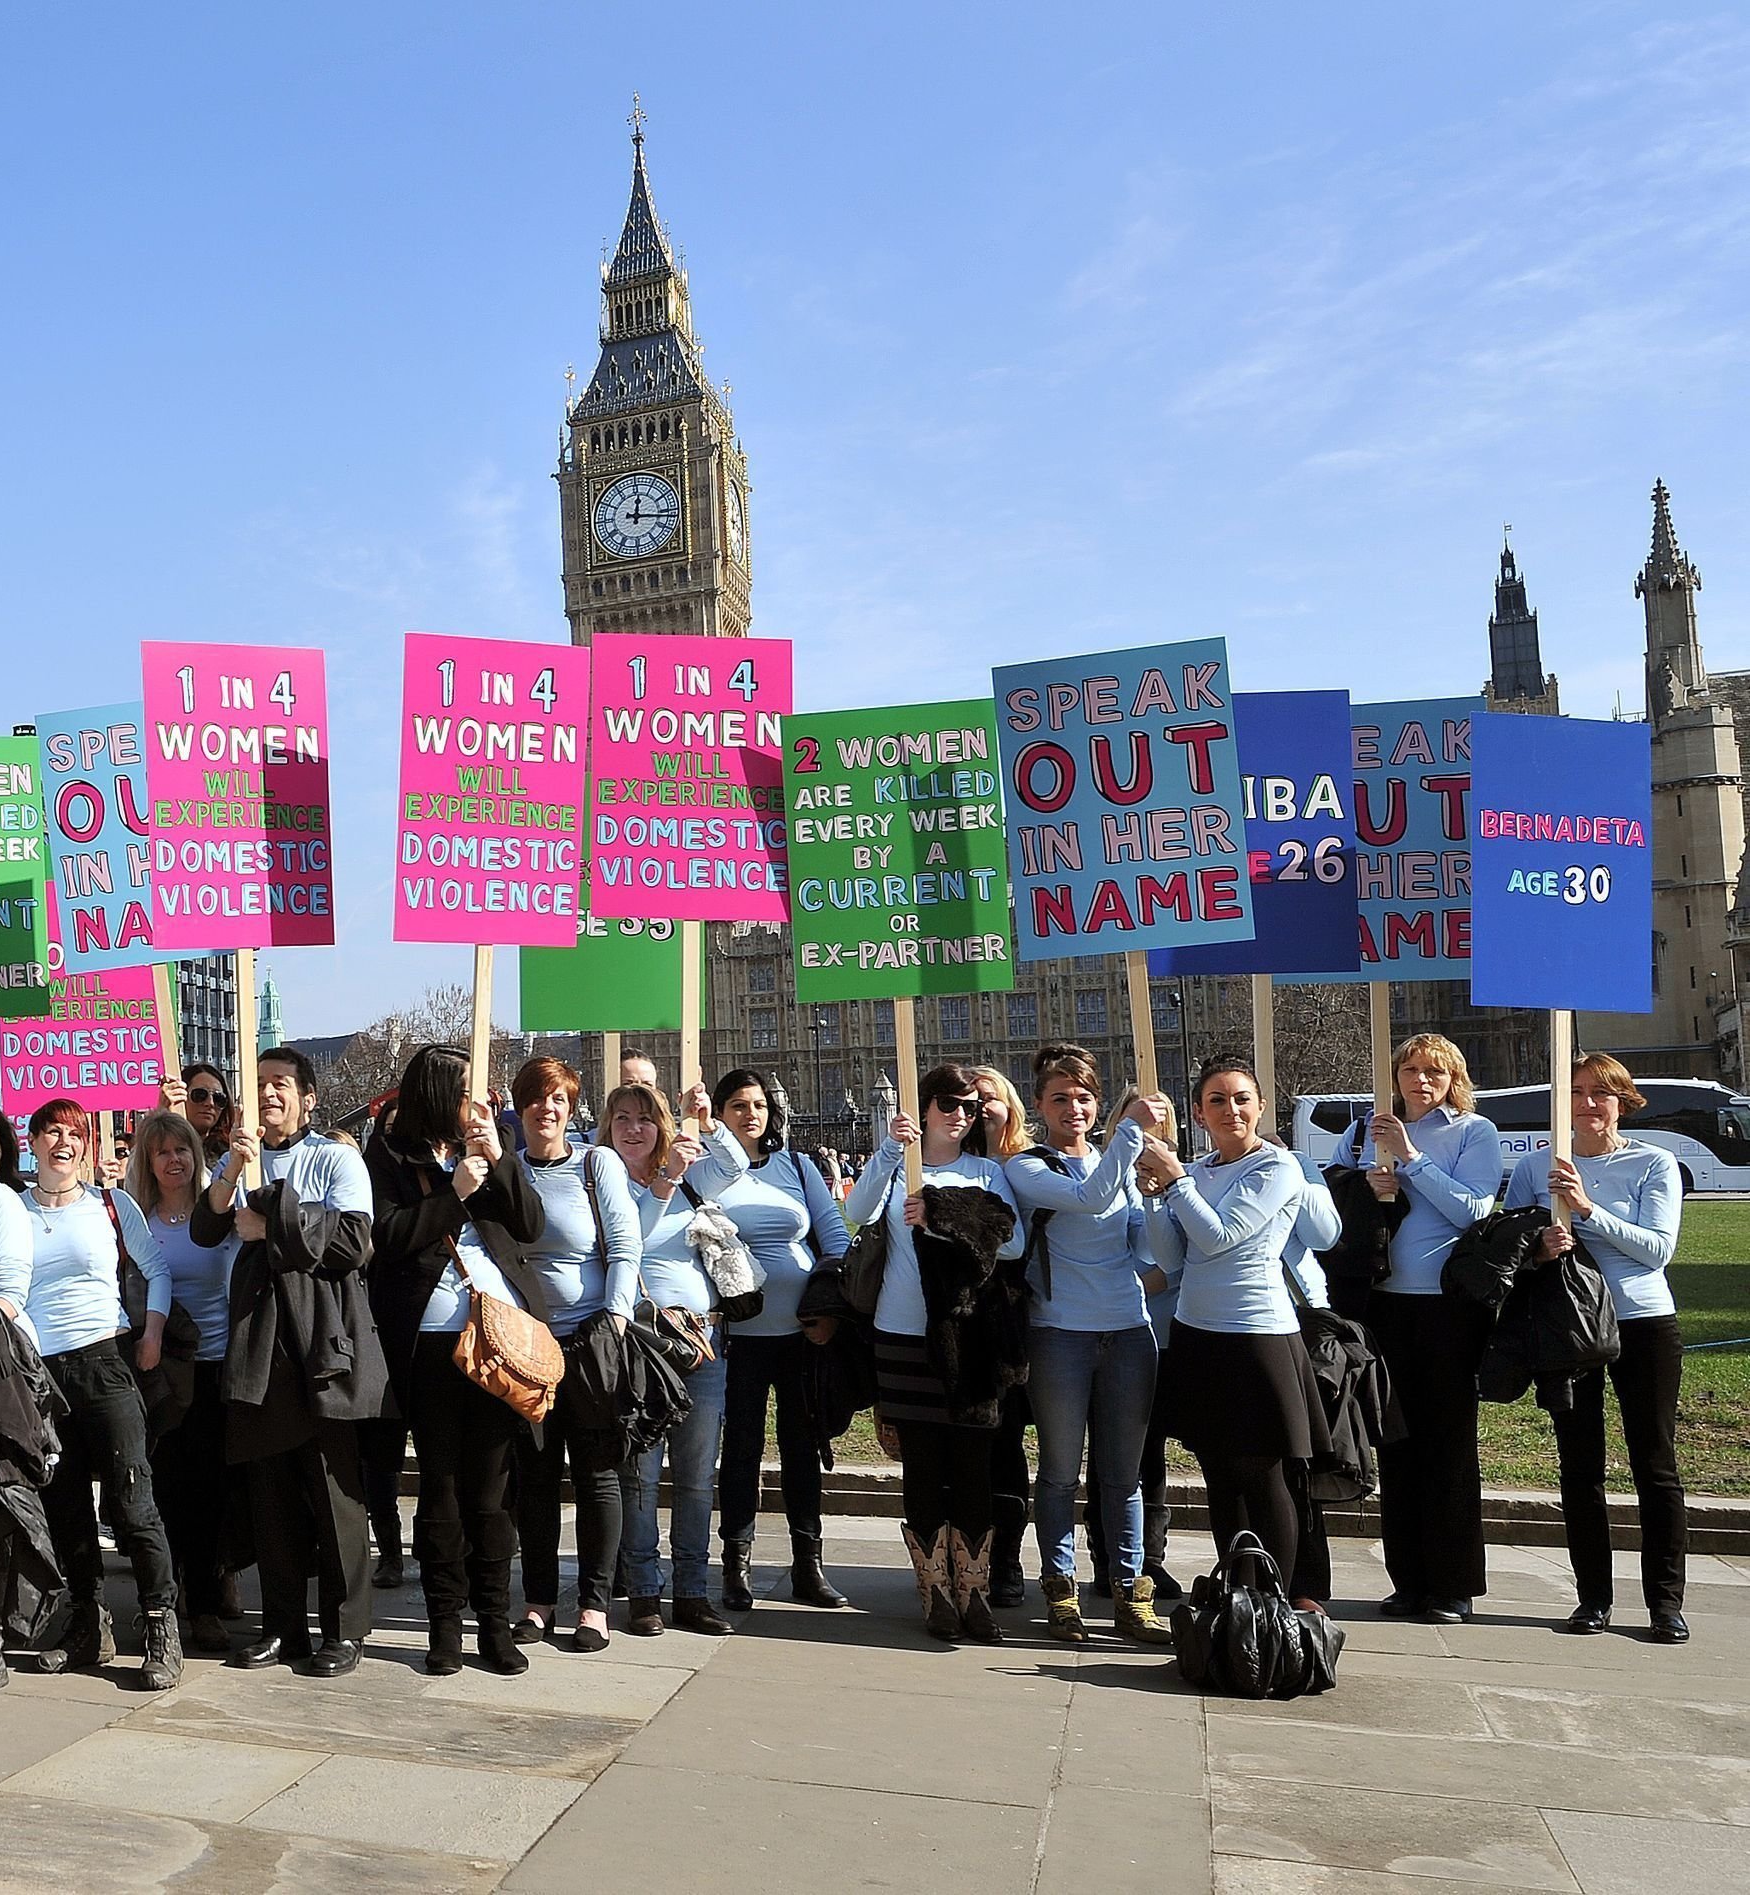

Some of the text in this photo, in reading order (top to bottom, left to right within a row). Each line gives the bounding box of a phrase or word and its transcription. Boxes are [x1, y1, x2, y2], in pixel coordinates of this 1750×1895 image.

[175, 666, 296, 717] 1 IN 4
[438, 658, 557, 713] 1 IN 4
[628, 656, 759, 702] 1 IN 4
[1007, 662, 1225, 732] SPEAK
[47, 723, 141, 772] SPE
[156, 723, 320, 765] WOMEN
[413, 715, 577, 763] WOMEN
[602, 706, 782, 749] WOMEN
[651, 751, 730, 780] WILL
[793, 727, 989, 775] 2 WOMEN
[1014, 721, 1228, 813] OUT
[203, 769, 275, 799] WILL
[456, 765, 528, 796] WILL
[597, 778, 785, 813] EXPERIENCE
[794, 769, 995, 811] ARE KILLED
[154, 800, 326, 832] EXPERIENCE
[405, 792, 576, 832] EXPERIENCE
[596, 814, 787, 850] DOMESTIC
[794, 803, 999, 845] EVERY WEEK
[1479, 809, 1645, 848] BERNADETA
[155, 839, 328, 875] DOMESTIC
[402, 831, 575, 873] DOMESTIC
[853, 841, 948, 870] BY A
[1020, 805, 1238, 876] IN HER
[1277, 836, 1346, 884] 26
[60, 850, 114, 900] IN
[598, 856, 788, 893] VIOLENCE
[798, 867, 997, 912] CURRENT
[1356, 851, 1471, 900] HER
[1506, 864, 1611, 906] AGE 30
[158, 883, 330, 917] VIOLENCE
[403, 876, 573, 916] VIOLENCE
[1032, 867, 1243, 938] NAME
[889, 912, 920, 933] OR
[801, 934, 1007, 969] EX-PARTNER
[49, 975, 109, 998] WILL
[4, 1025, 158, 1057] DOMESTIC
[6, 1060, 160, 1090] VIOLENCE
